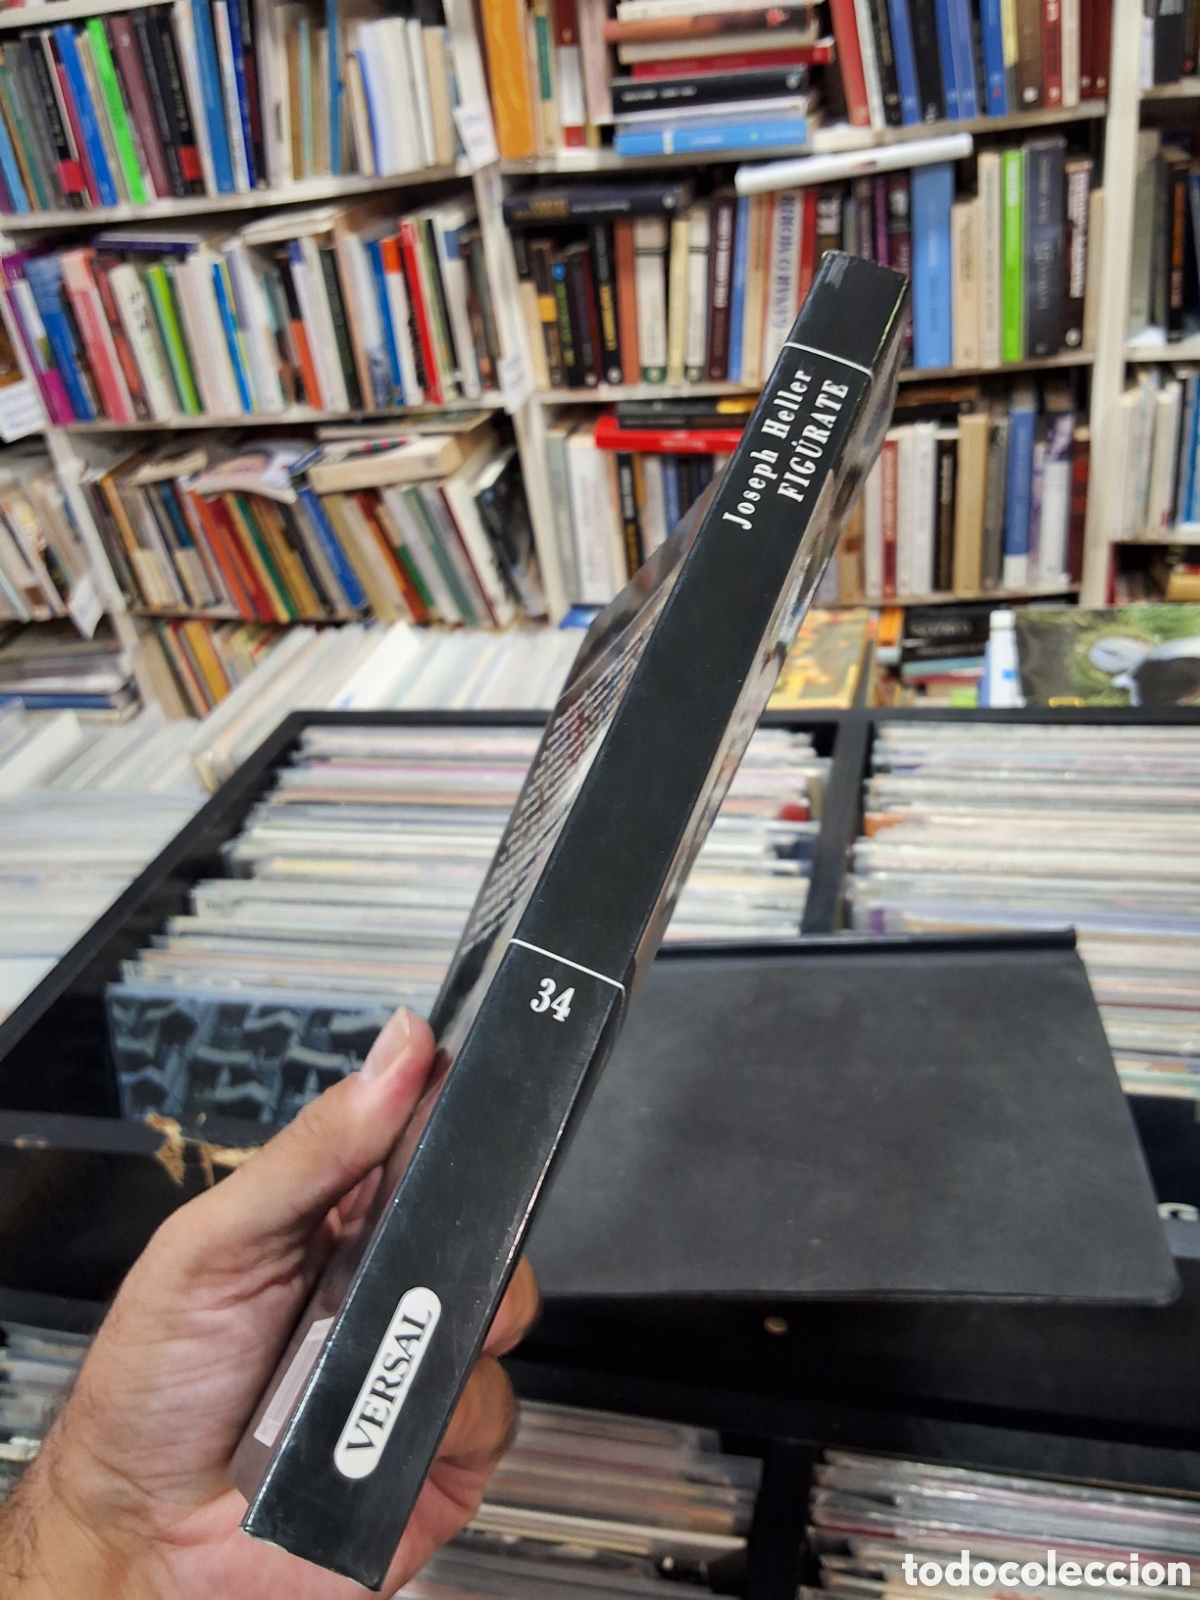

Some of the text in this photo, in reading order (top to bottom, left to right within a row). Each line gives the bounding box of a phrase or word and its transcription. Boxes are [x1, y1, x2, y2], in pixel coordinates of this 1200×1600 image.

[722, 369, 812, 530] Joseph Heller
[777, 379, 849, 503] FIGÚRATE
[529, 977, 576, 1022] 34
[344, 1309, 433, 1452] VERSAL
